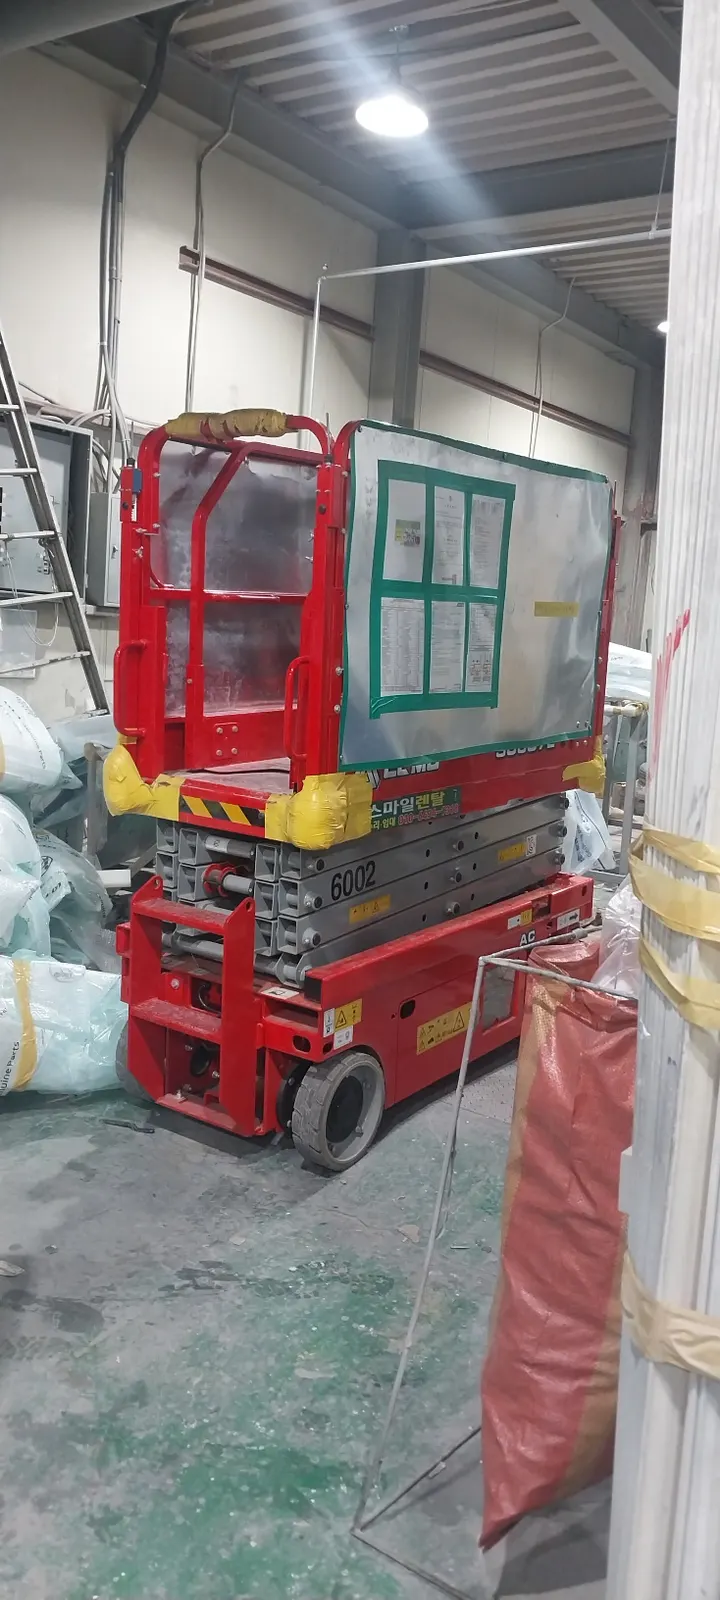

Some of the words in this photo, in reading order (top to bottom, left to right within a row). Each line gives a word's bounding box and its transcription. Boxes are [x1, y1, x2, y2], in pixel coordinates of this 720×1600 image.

[331, 860, 376, 901] 6002
[519, 930, 536, 947] AC
[7, 1041, 20, 1067] Parts
